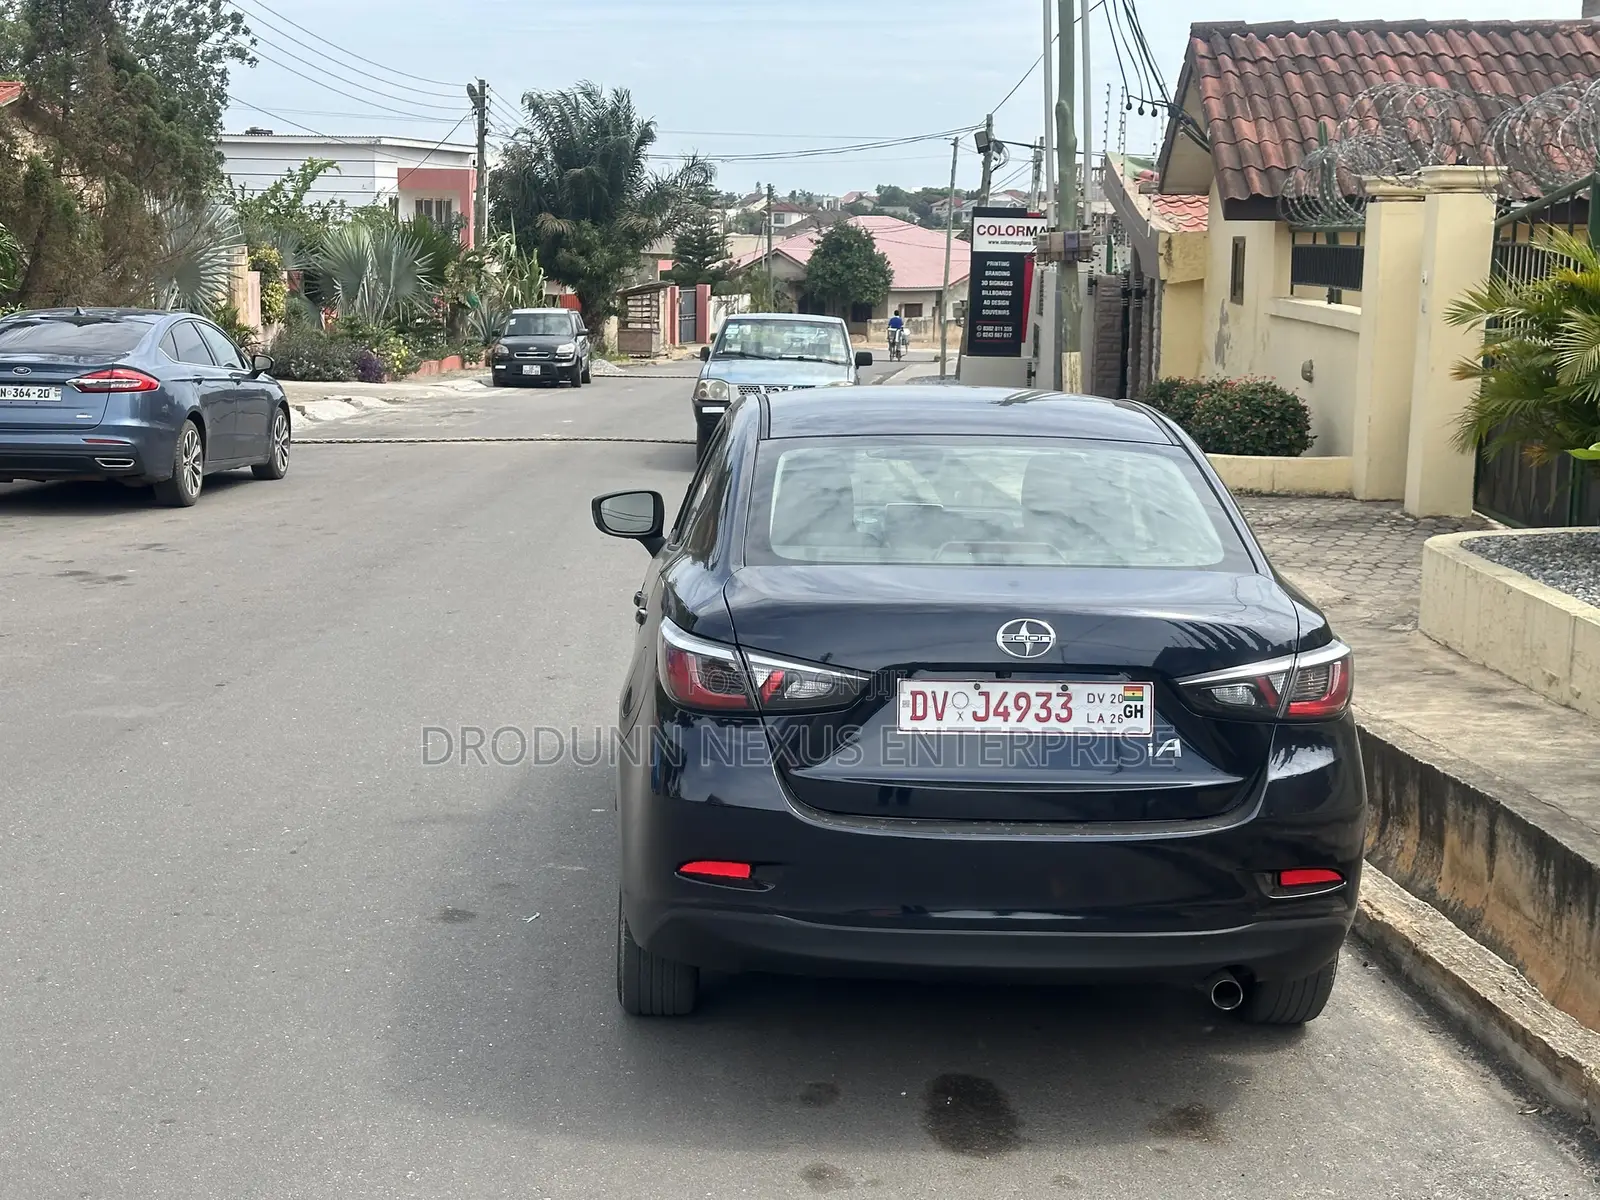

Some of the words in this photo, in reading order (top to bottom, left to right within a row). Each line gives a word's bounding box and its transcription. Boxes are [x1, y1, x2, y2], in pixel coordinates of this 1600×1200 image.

[977, 224, 1048, 237] COLORMA
[12, 388, 50, 399] 364-20
[1087, 693, 1105, 704] DV
[1110, 693, 1123, 704] 20
[910, 690, 949, 721] DV
[972, 691, 1073, 723] J4933
[1123, 704, 1144, 719] GH
[1087, 713, 1105, 723] LA
[1110, 713, 1124, 724] 26
[1147, 738, 1182, 758] iA
